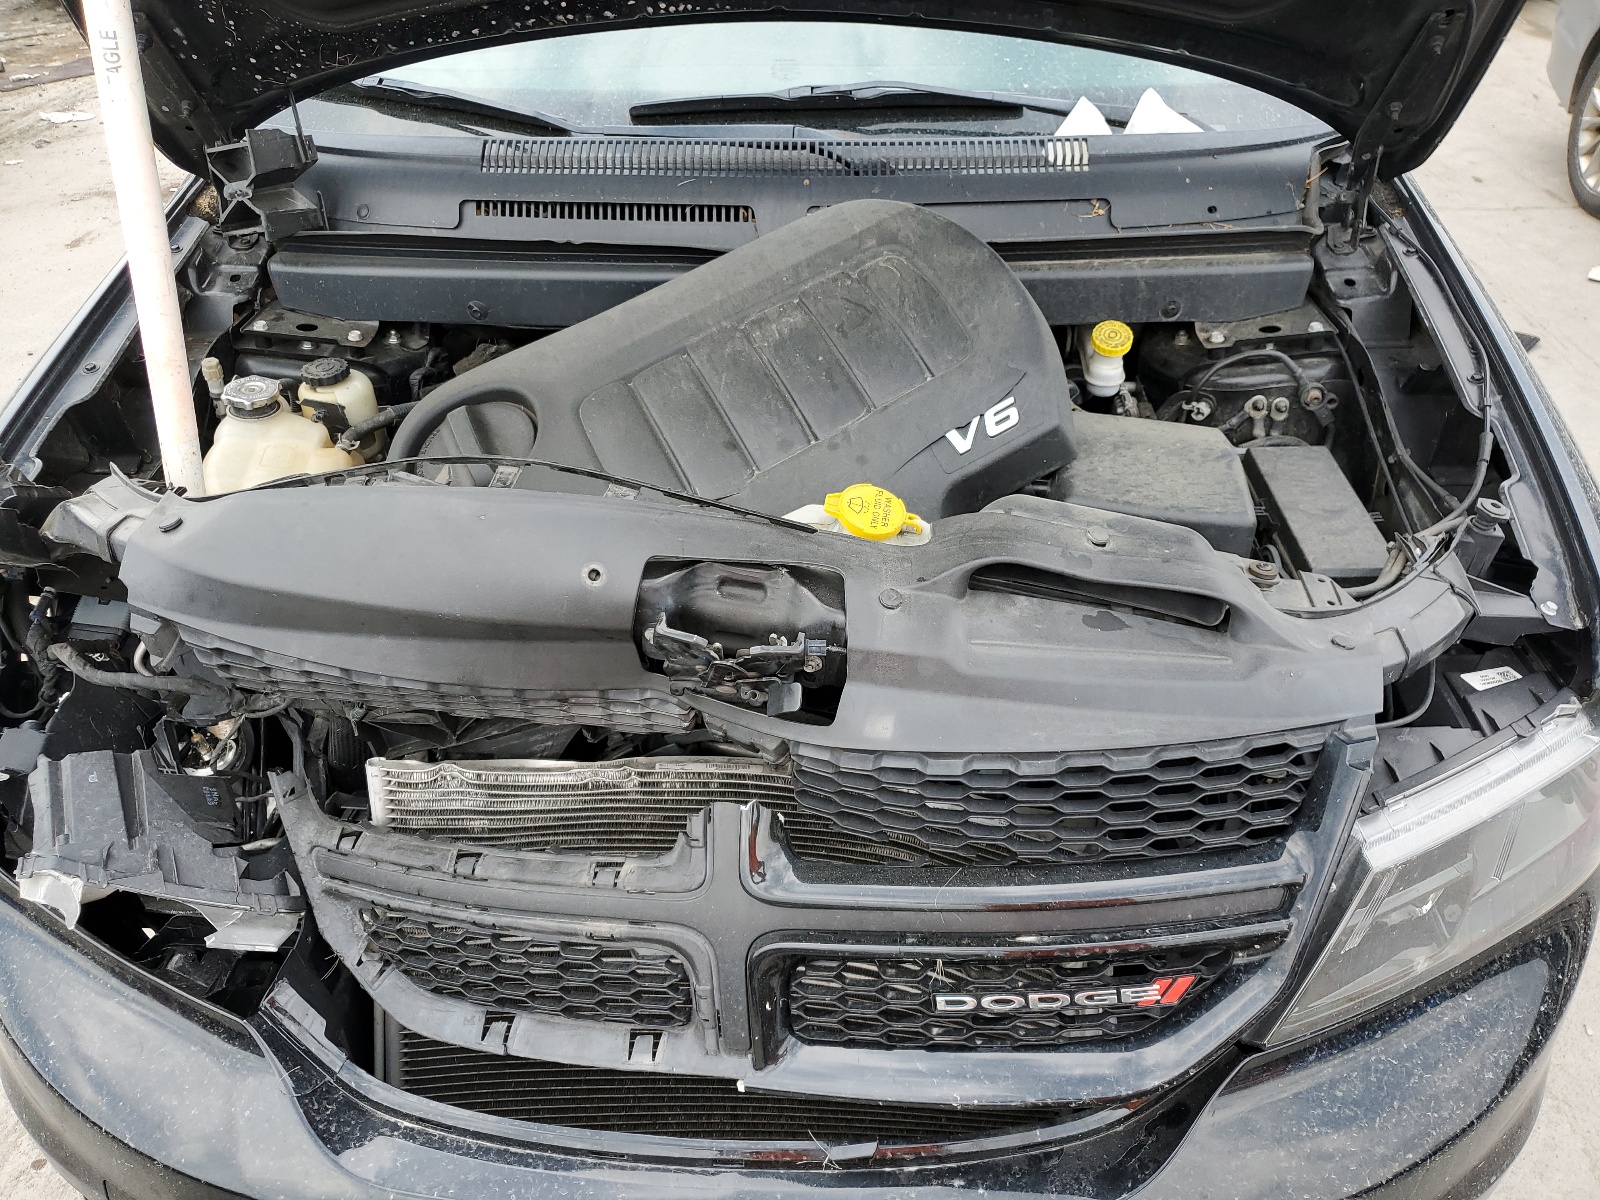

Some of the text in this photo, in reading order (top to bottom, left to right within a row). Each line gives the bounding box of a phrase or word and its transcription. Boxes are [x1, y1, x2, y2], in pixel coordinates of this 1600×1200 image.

[99, 30, 123, 84] AGLE
[945, 396, 1020, 455] V6
[870, 489, 884, 530] FLUID ONLY
[881, 497, 892, 528] WASHER
[935, 984, 1161, 1012] DODGE
